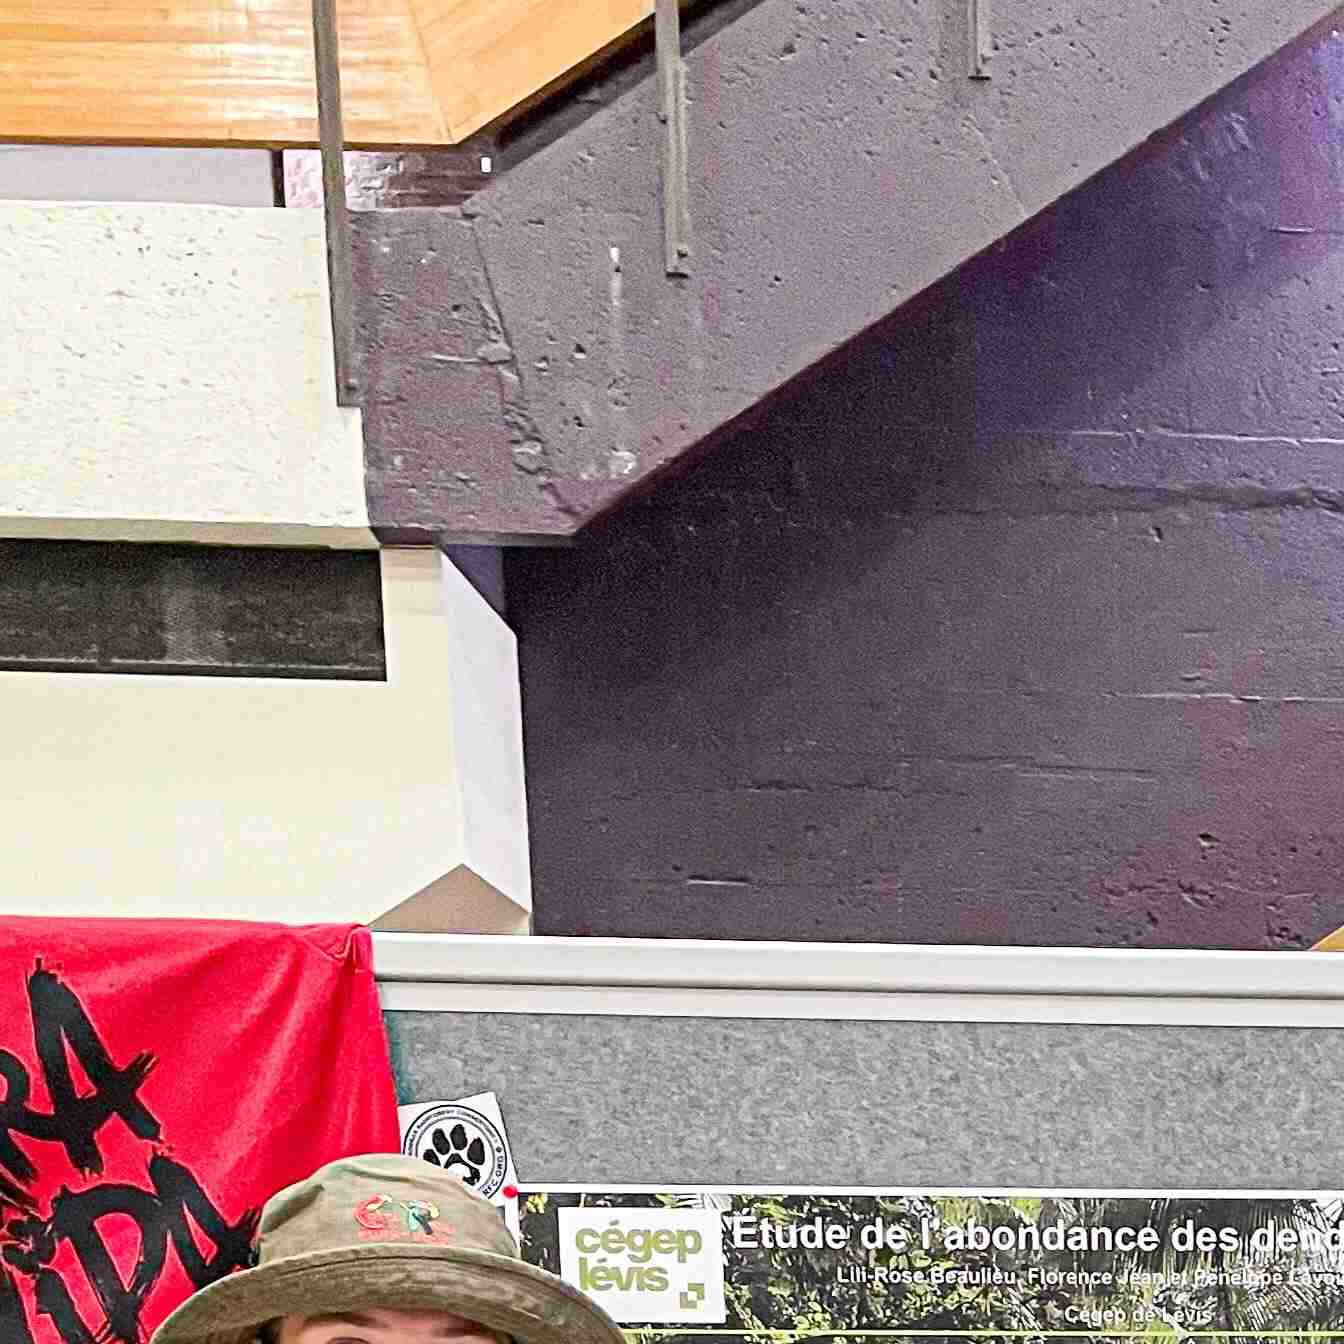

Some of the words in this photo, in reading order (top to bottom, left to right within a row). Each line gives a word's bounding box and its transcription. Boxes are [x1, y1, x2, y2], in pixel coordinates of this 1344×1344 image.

[575, 1219, 703, 1263] cégep
[735, 1208, 847, 1250] Étude
[860, 1216, 904, 1250] de
[919, 1216, 1160, 1251] l'abondance
[1171, 1219, 1240, 1252] des
[577, 1257, 670, 1293] lévis
[1028, 1267, 1112, 1286] Florence
[1133, 1305, 1153, 1323] de
